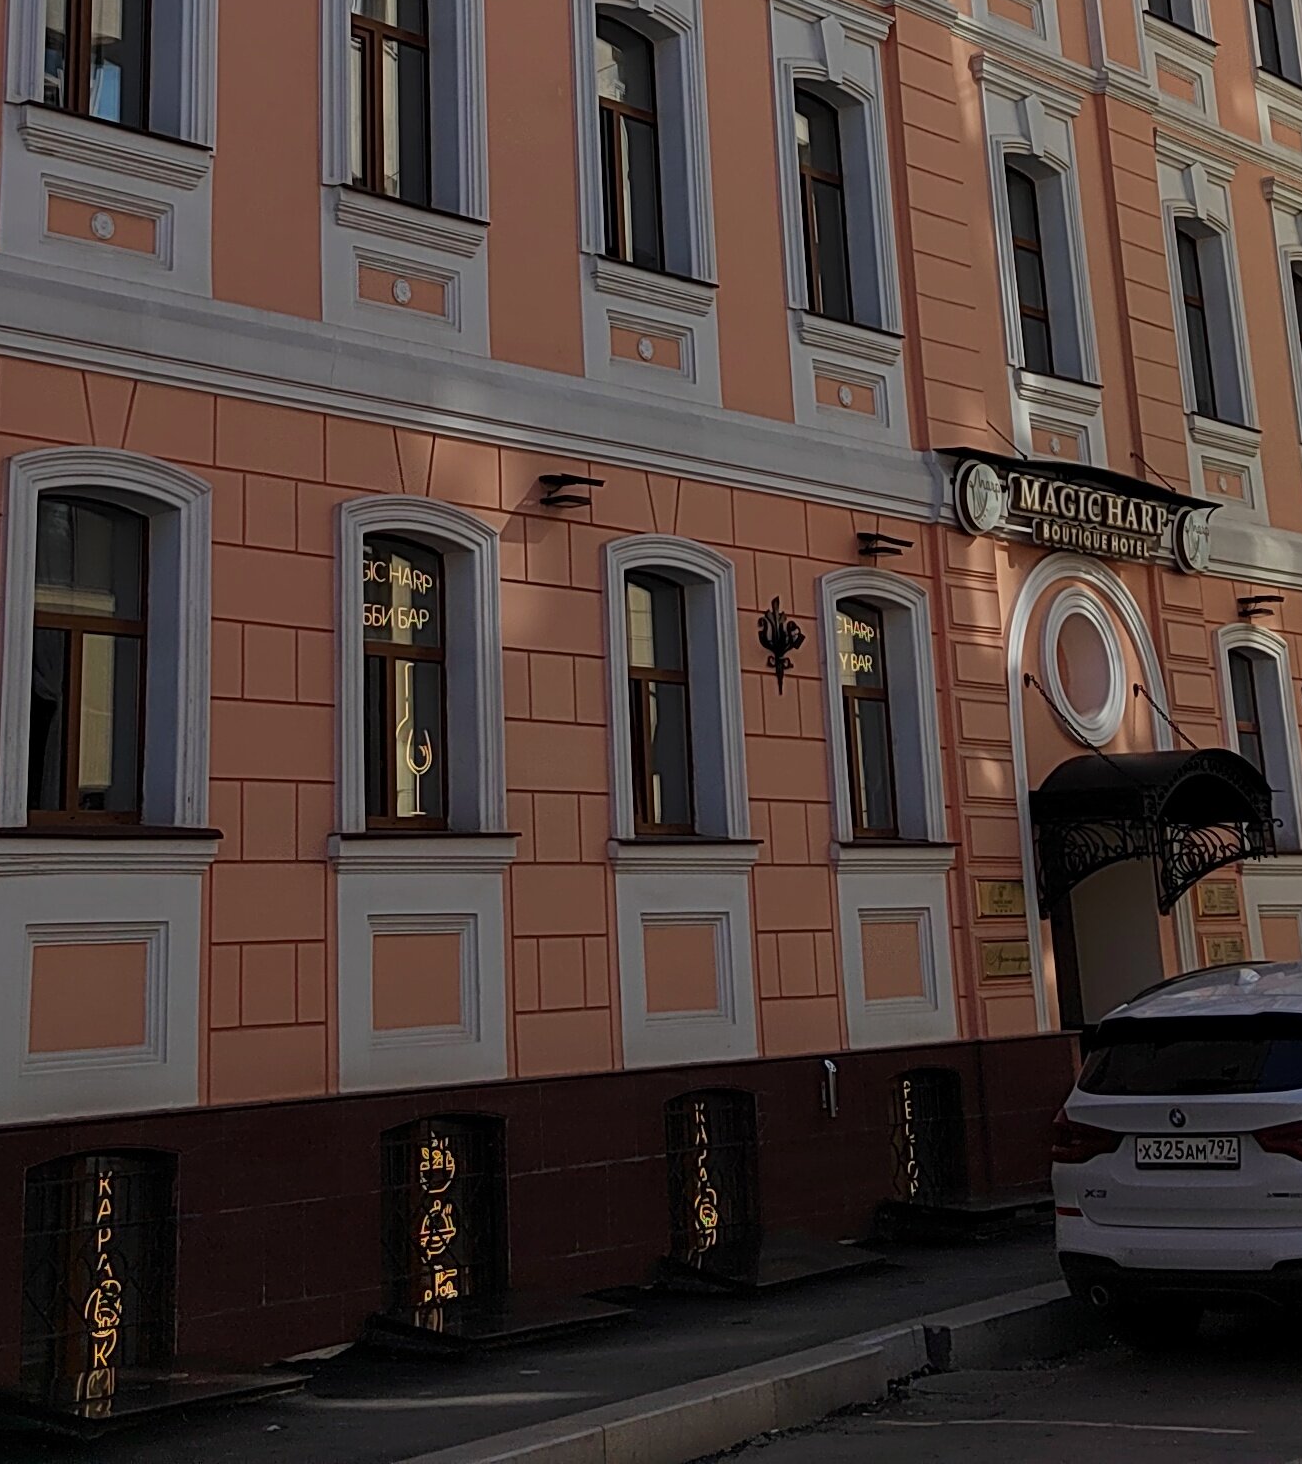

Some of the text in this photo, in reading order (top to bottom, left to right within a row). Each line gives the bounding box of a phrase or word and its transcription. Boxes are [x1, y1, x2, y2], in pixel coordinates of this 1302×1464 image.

[1019, 477, 1168, 535] MAGIC HARP
[1042, 521, 1150, 558] BOUTIQUE HOTEL
[389, 562, 433, 596] HARP
[397, 606, 430, 631] БАР
[843, 617, 875, 643] HARP
[850, 652, 874, 673] BAR
[1084, 1188, 1108, 1199] X3
